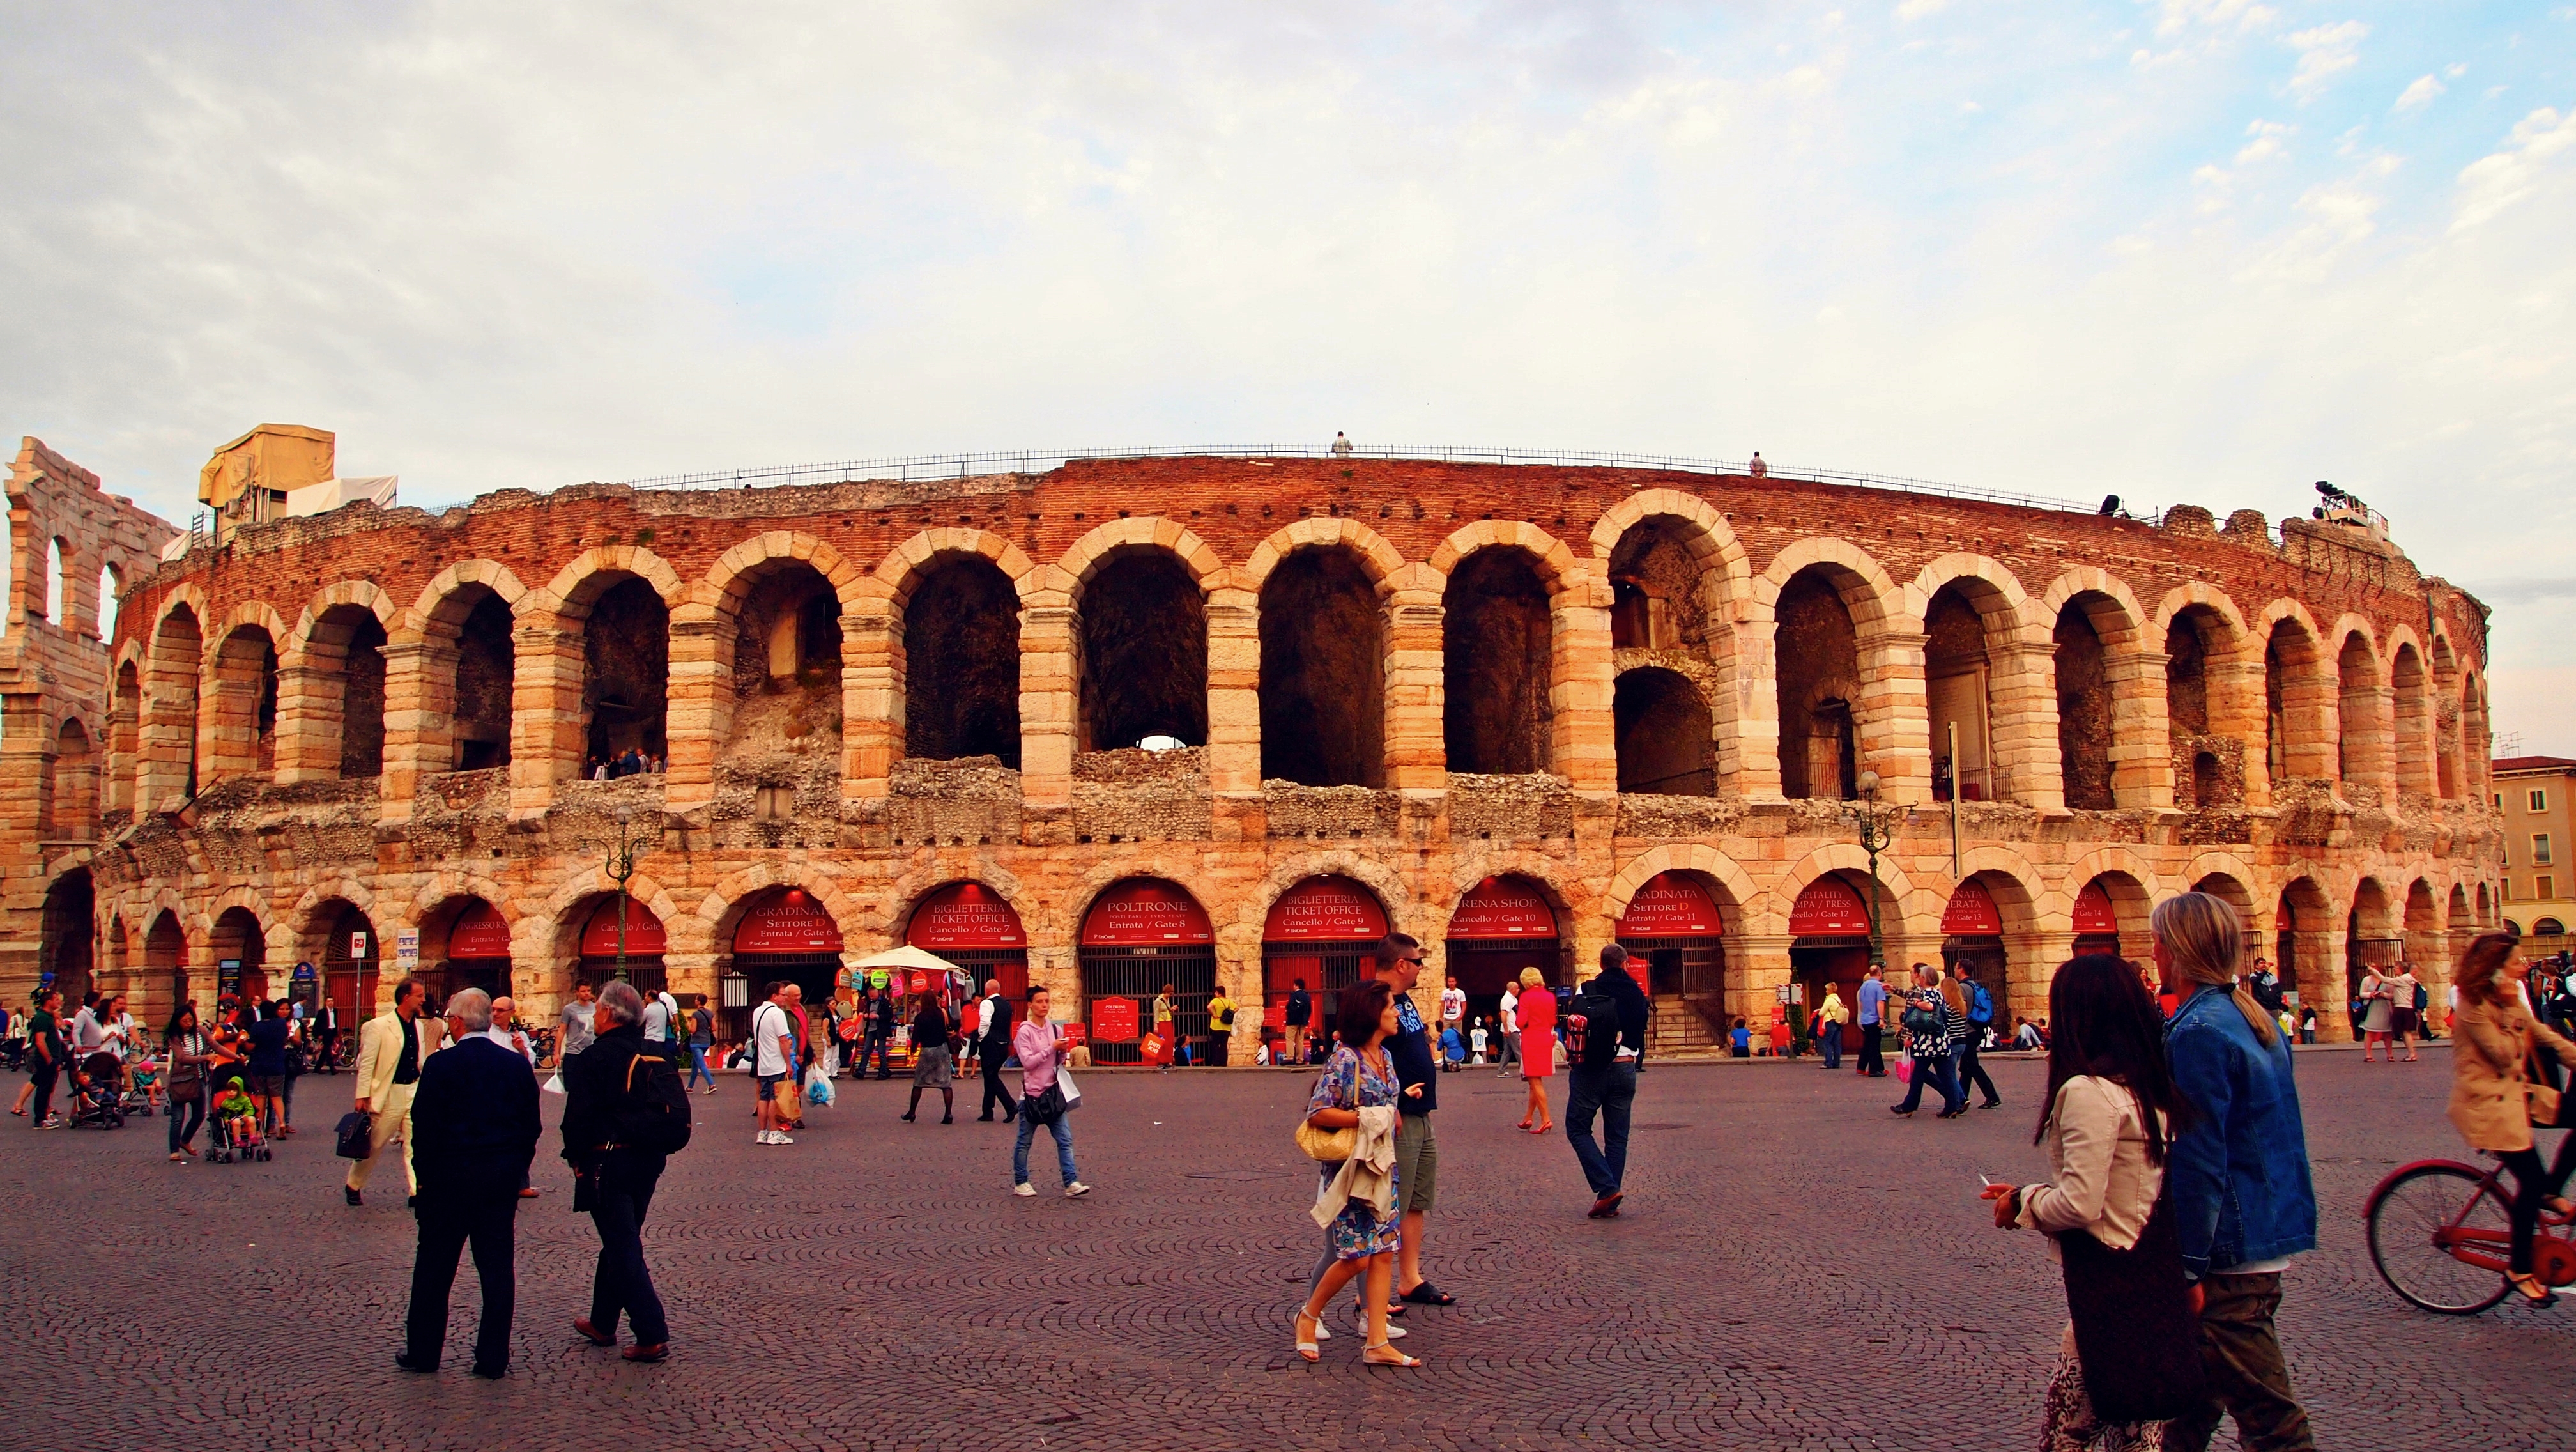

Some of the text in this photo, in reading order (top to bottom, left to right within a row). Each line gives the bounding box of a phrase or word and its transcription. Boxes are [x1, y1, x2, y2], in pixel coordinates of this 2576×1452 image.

[1634, 890, 1698, 899] RADINATA
[1288, 895, 1358, 904] BIGLIETTERIA
[1501, 899, 1537, 908] SHOP
[934, 904, 1004, 913] BIGLIETTERIA
[1107, 902, 1188, 912] POLTRONE
[1948, 900, 1981, 909] ERATA
[1284, 906, 1362, 915] TICKET OFFICE
[931, 914, 1008, 923] TICKET OFFICE
[1283, 918, 1322, 926] Cancello
[461, 922, 494, 930] INGRESSO
[601, 923, 633, 931] Cancllo
[643, 922, 661, 931] Gate
[767, 919, 813, 928] SETTORE
